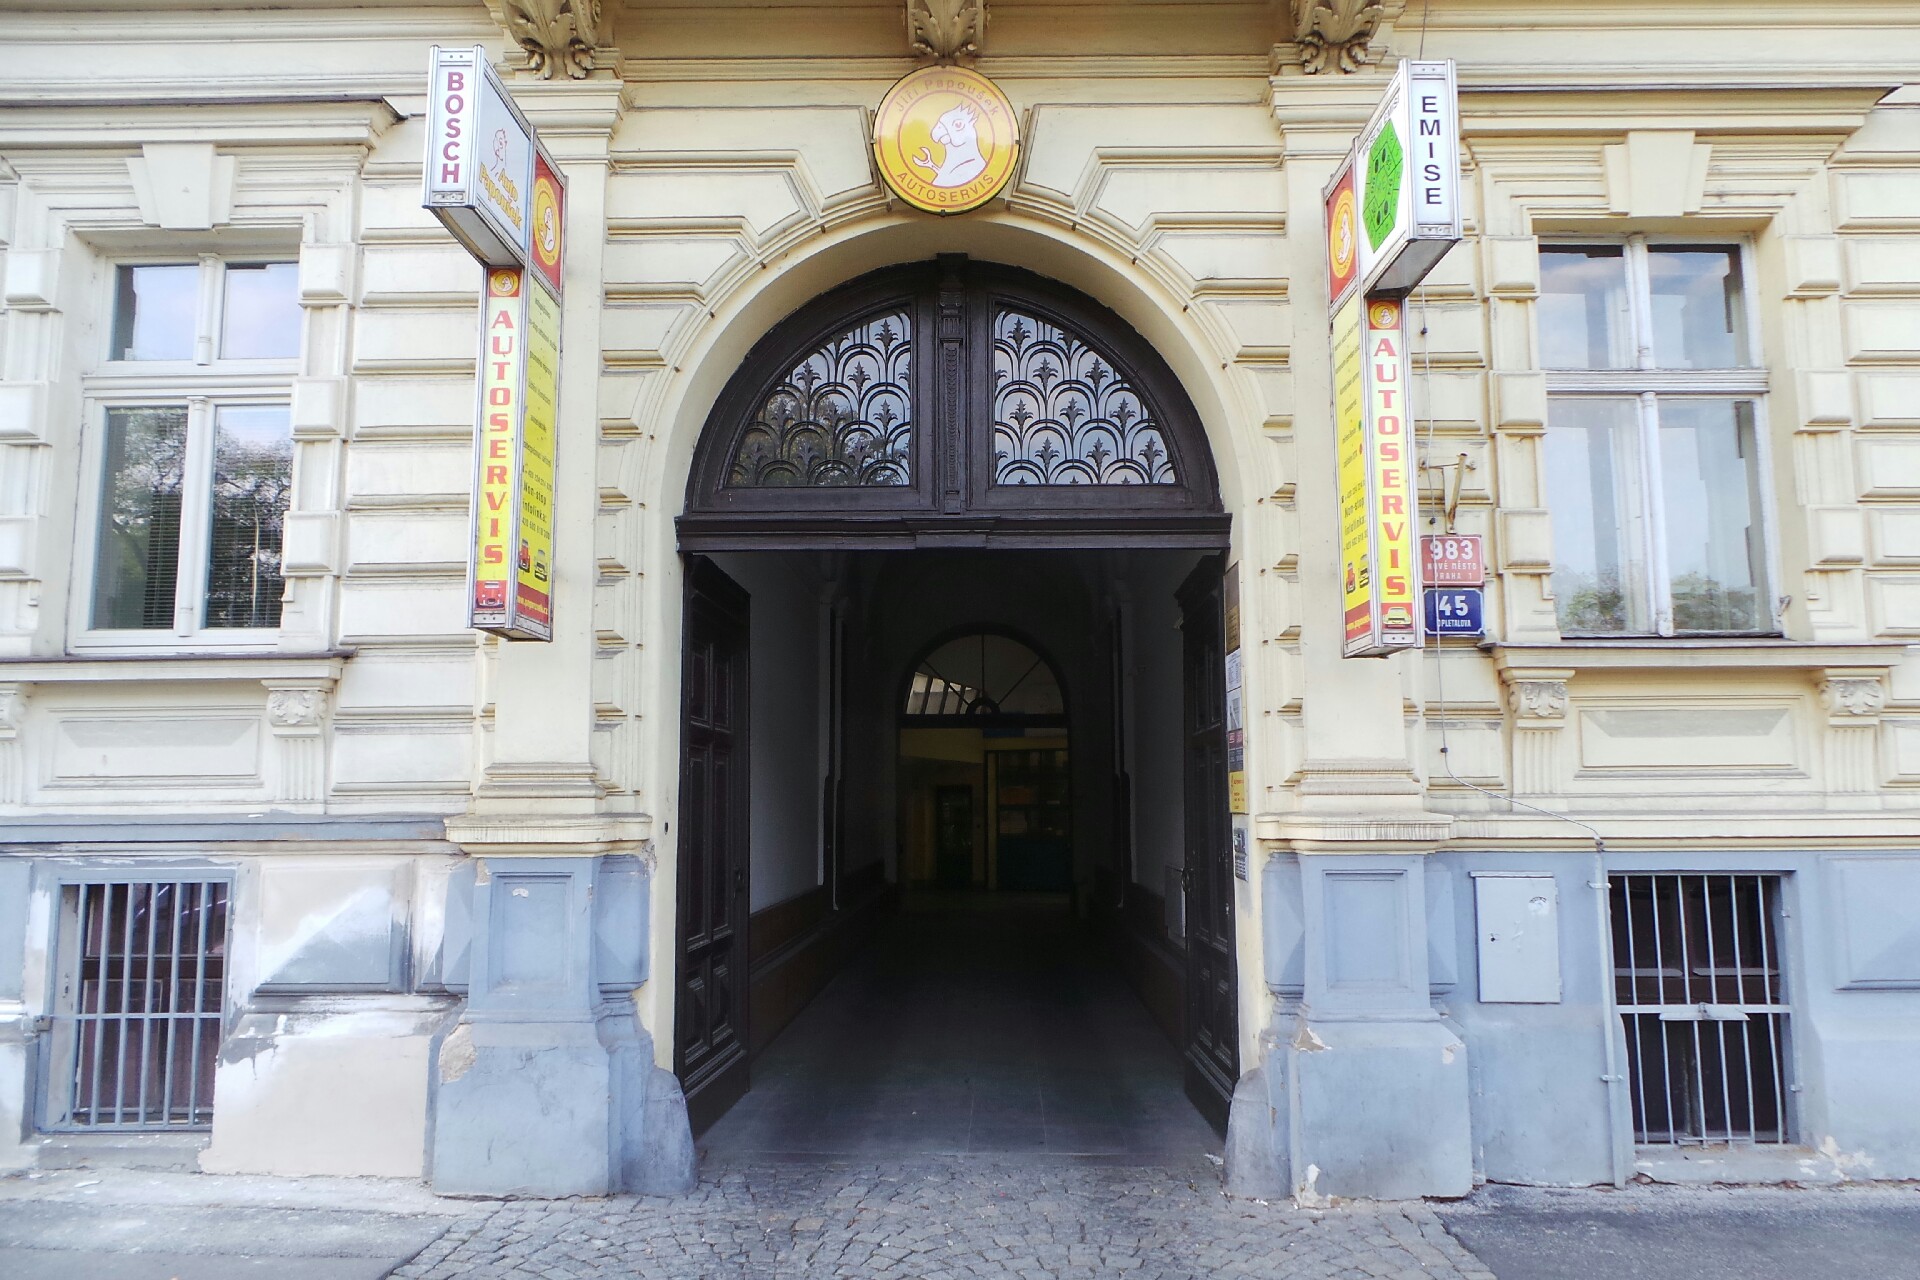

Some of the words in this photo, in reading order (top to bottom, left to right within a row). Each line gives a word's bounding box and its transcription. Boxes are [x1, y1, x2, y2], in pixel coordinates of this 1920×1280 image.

[896, 87, 919, 112] Jiří
[925, 79, 999, 116] Papoušek
[441, 72, 464, 184] BOSCH
[1419, 96, 1443, 205] EMISE
[498, 168, 518, 202] Auto
[897, 171, 994, 203] AUTOSERVIS
[484, 310, 514, 564] AUTOSERVIS
[1374, 338, 1406, 595] AUTOSERVIS
[524, 480, 547, 506] Non-stop
[1430, 540, 1473, 560] 983
[1451, 560, 1477, 570] MĚSTO
[1439, 595, 1468, 616] 45
